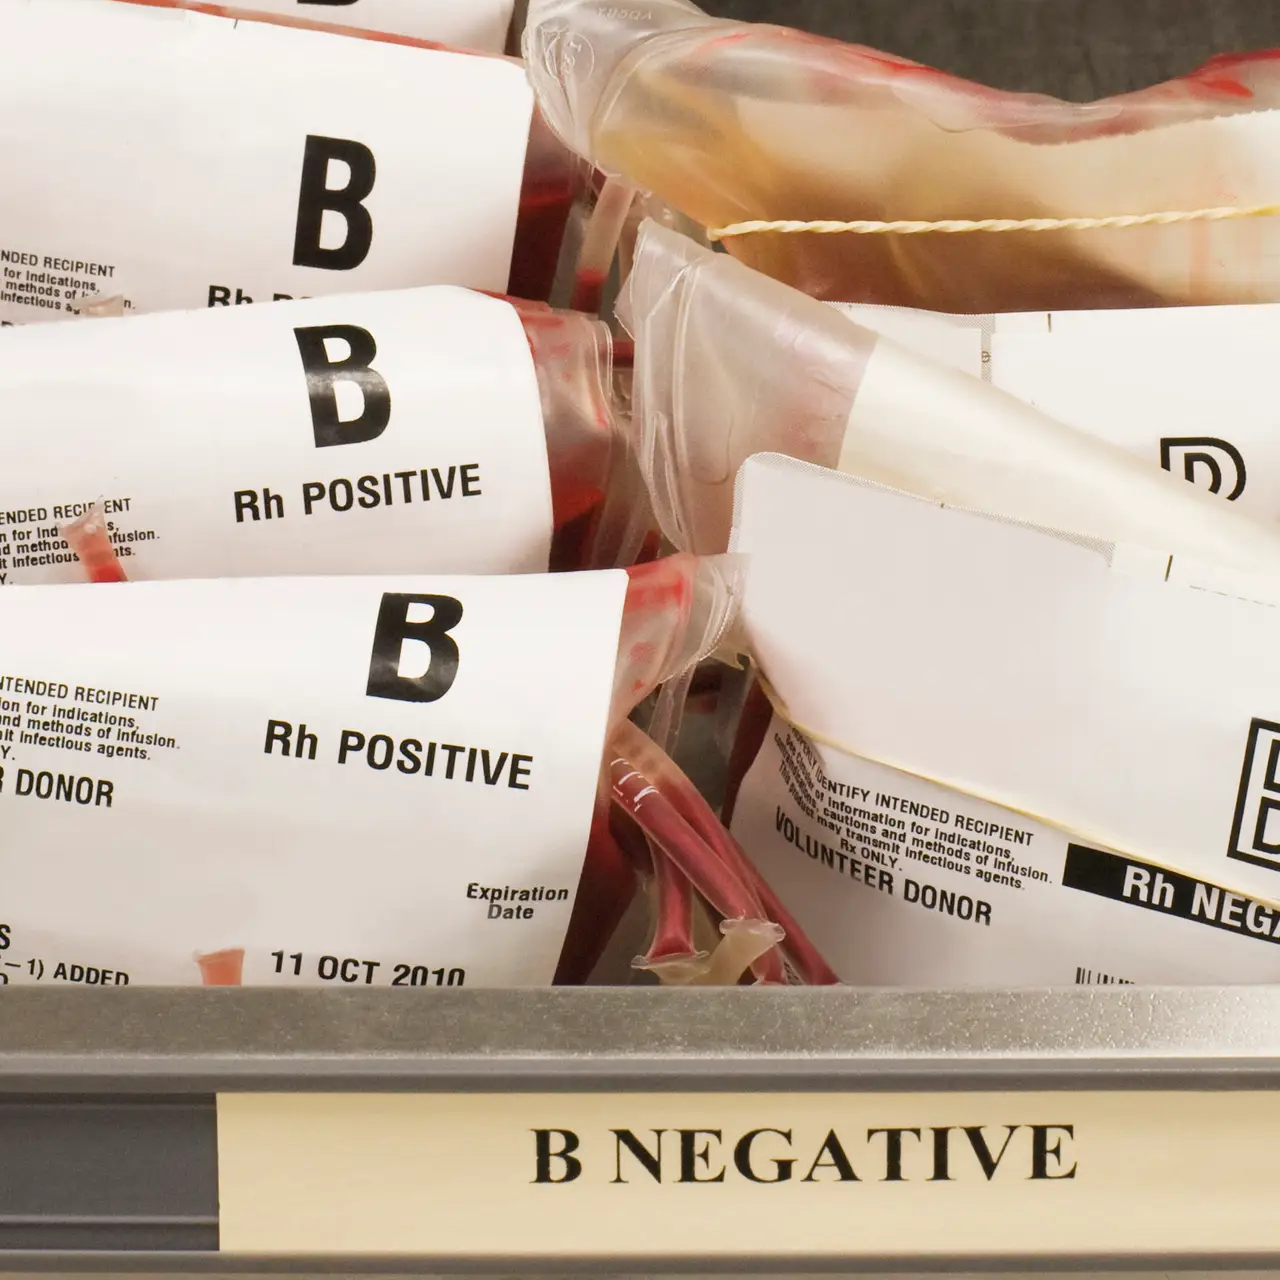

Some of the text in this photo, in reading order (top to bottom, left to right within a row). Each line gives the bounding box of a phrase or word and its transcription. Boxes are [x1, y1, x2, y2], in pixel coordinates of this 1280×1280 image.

[293, 135, 376, 270] B
[43, 256, 115, 277] RECIPIENT
[294, 325, 390, 448] B
[234, 463, 482, 523] Rh POSITIVE
[366, 593, 463, 703] B
[26, 701, 47, 716] for
[74, 686, 159, 711] RECIPIENT
[27, 719, 92, 737] methods
[97, 727, 112, 739] of
[97, 744, 150, 760] agents.
[264, 719, 533, 790] Rh POSITIVE
[15, 768, 114, 807] DONOR
[875, 793, 1034, 846] INTENDED RECIPIENT
[776, 805, 992, 926] VOLUNTEER DONOR
[466, 883, 569, 906] Expiration
[1122, 865, 1175, 908] Rh
[487, 904, 534, 919] Date
[271, 950, 302, 976] 11
[318, 956, 380, 984] OCT
[531, 1124, 1077, 1184] B NEGATIVE
